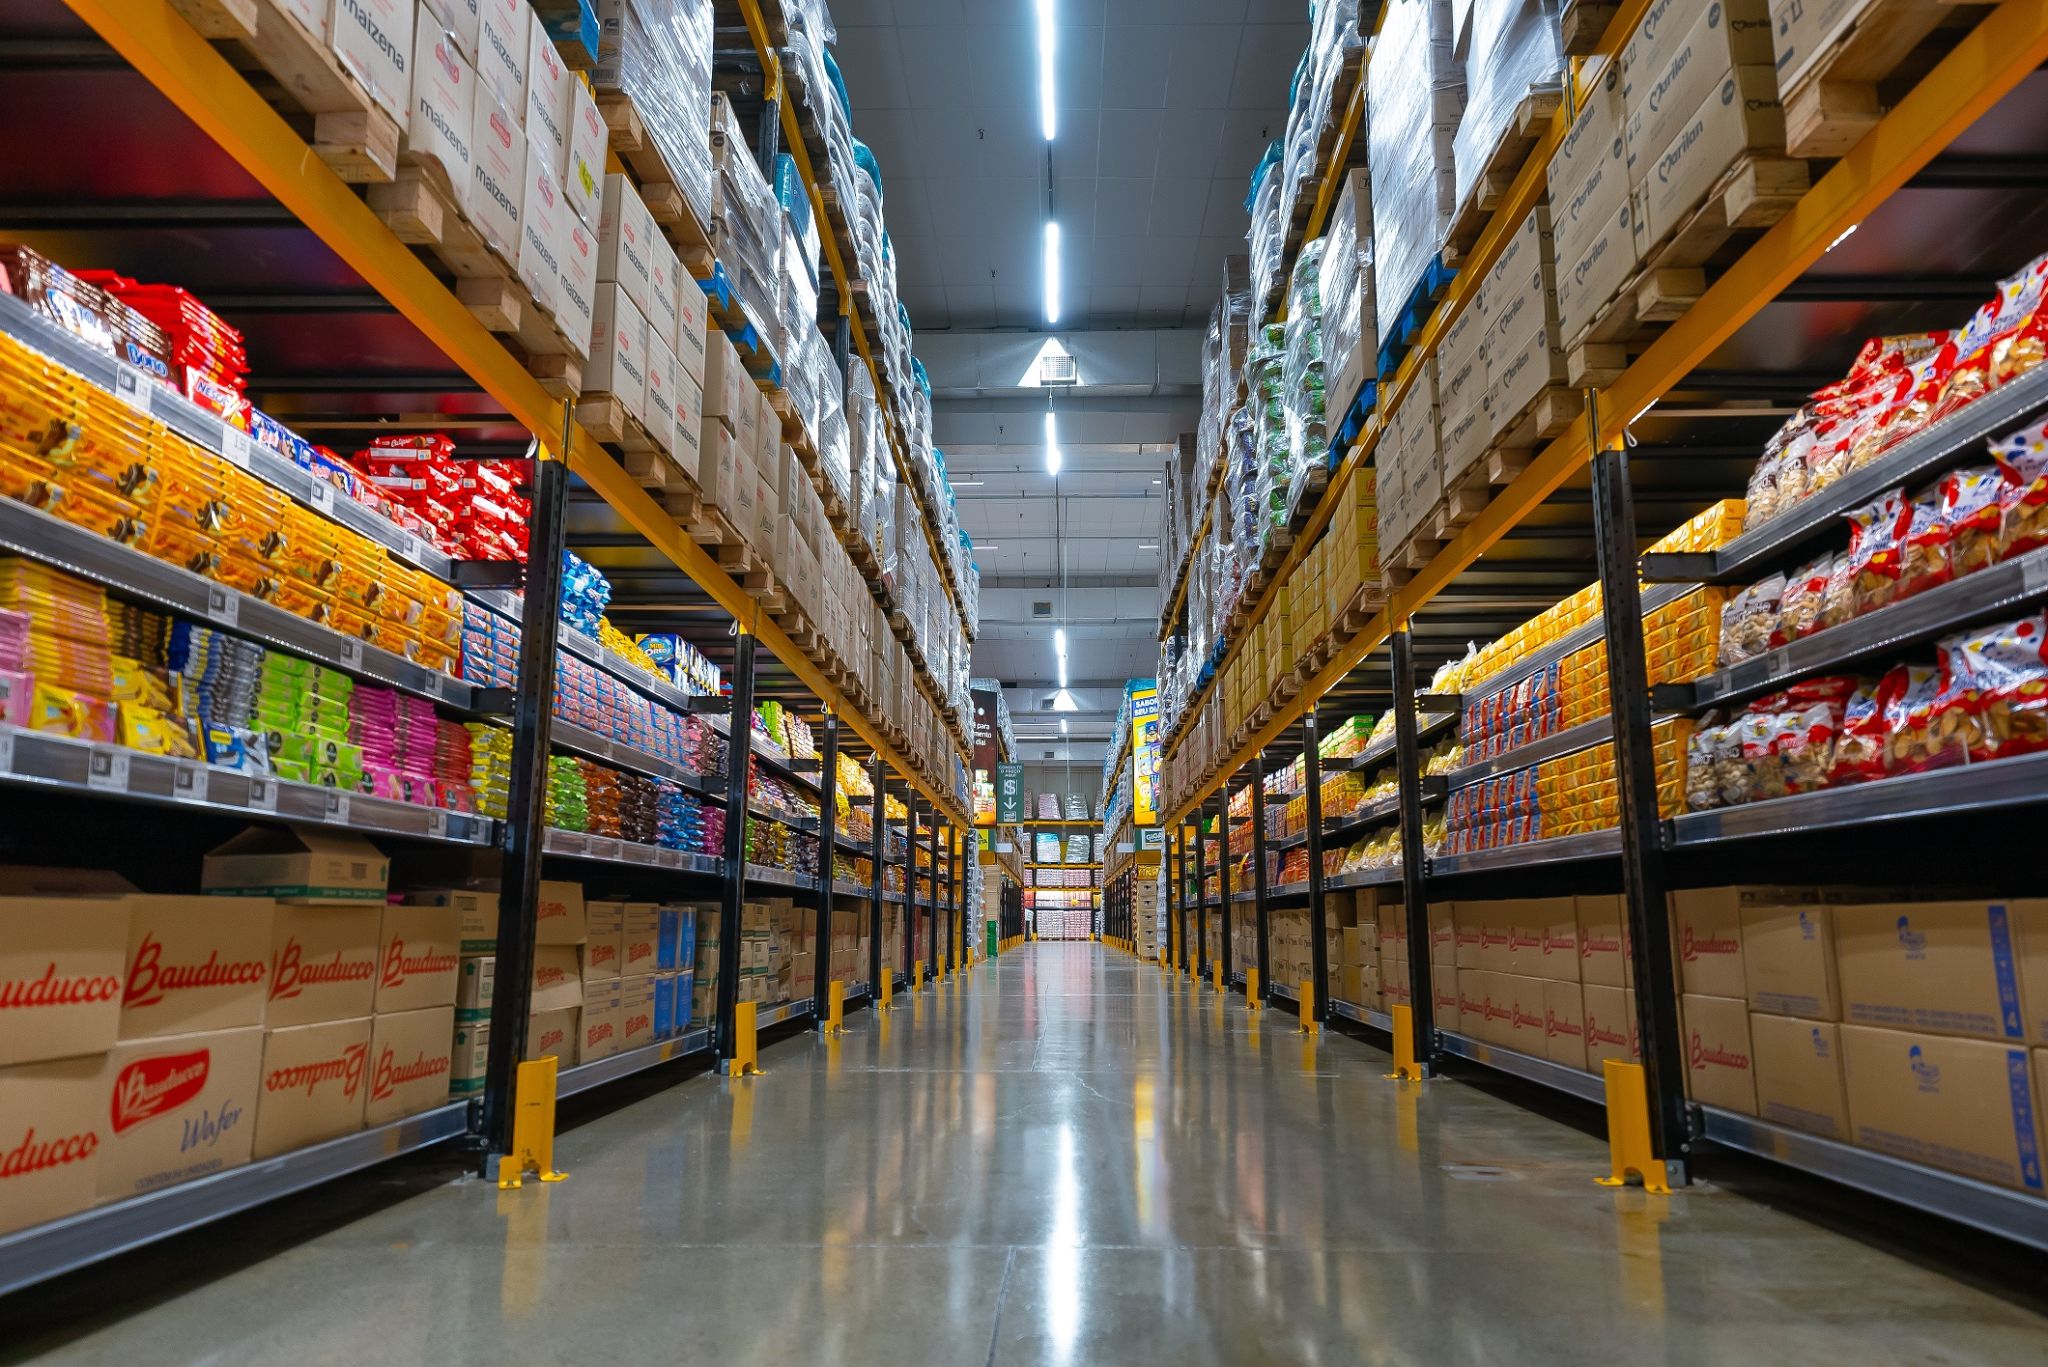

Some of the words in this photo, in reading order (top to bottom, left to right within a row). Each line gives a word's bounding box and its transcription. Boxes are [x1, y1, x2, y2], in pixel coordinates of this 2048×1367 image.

[484, 19, 522, 86] maizena
[1650, 46, 1692, 112] Marilan
[420, 97, 469, 163] maizena
[531, 90, 562, 147] maizena
[1564, 104, 1595, 158] Marilan
[1658, 120, 1703, 182] Marilan
[475, 163, 518, 222] maizena
[1571, 170, 1602, 221] Marilan
[526, 223, 558, 274] maizena
[623, 241, 648, 283] maizena
[1495, 241, 1520, 280] Marilan
[1576, 236, 1608, 286] Marilan
[560, 274, 590, 319] maizena
[654, 284, 675, 320] maizena
[1500, 295, 1525, 333] Marilan
[1448, 313, 1470, 347] Marilan
[617, 352, 643, 387] maizena
[1452, 363, 1473, 396] Marilan
[1503, 351, 1529, 388] Marilan
[651, 388, 673, 420] maizena
[1453, 412, 1476, 444] Marilan
[676, 422, 698, 450] maizena
[268, 935, 374, 1002] Bauducco
[380, 933, 458, 989] Bauducco
[1682, 927, 1739, 962] Bauducco
[0, 962, 120, 1009] uducco
[122, 931, 266, 1010] Bauducco
[266, 1042, 368, 1104] Bauducco
[371, 1043, 449, 1103] Bauducco
[1691, 1030, 1749, 1070] Bauducco
[119, 1062, 207, 1124] Bauducco
[181, 1099, 243, 1154] Wafer
[0, 1128, 99, 1179] ducco
